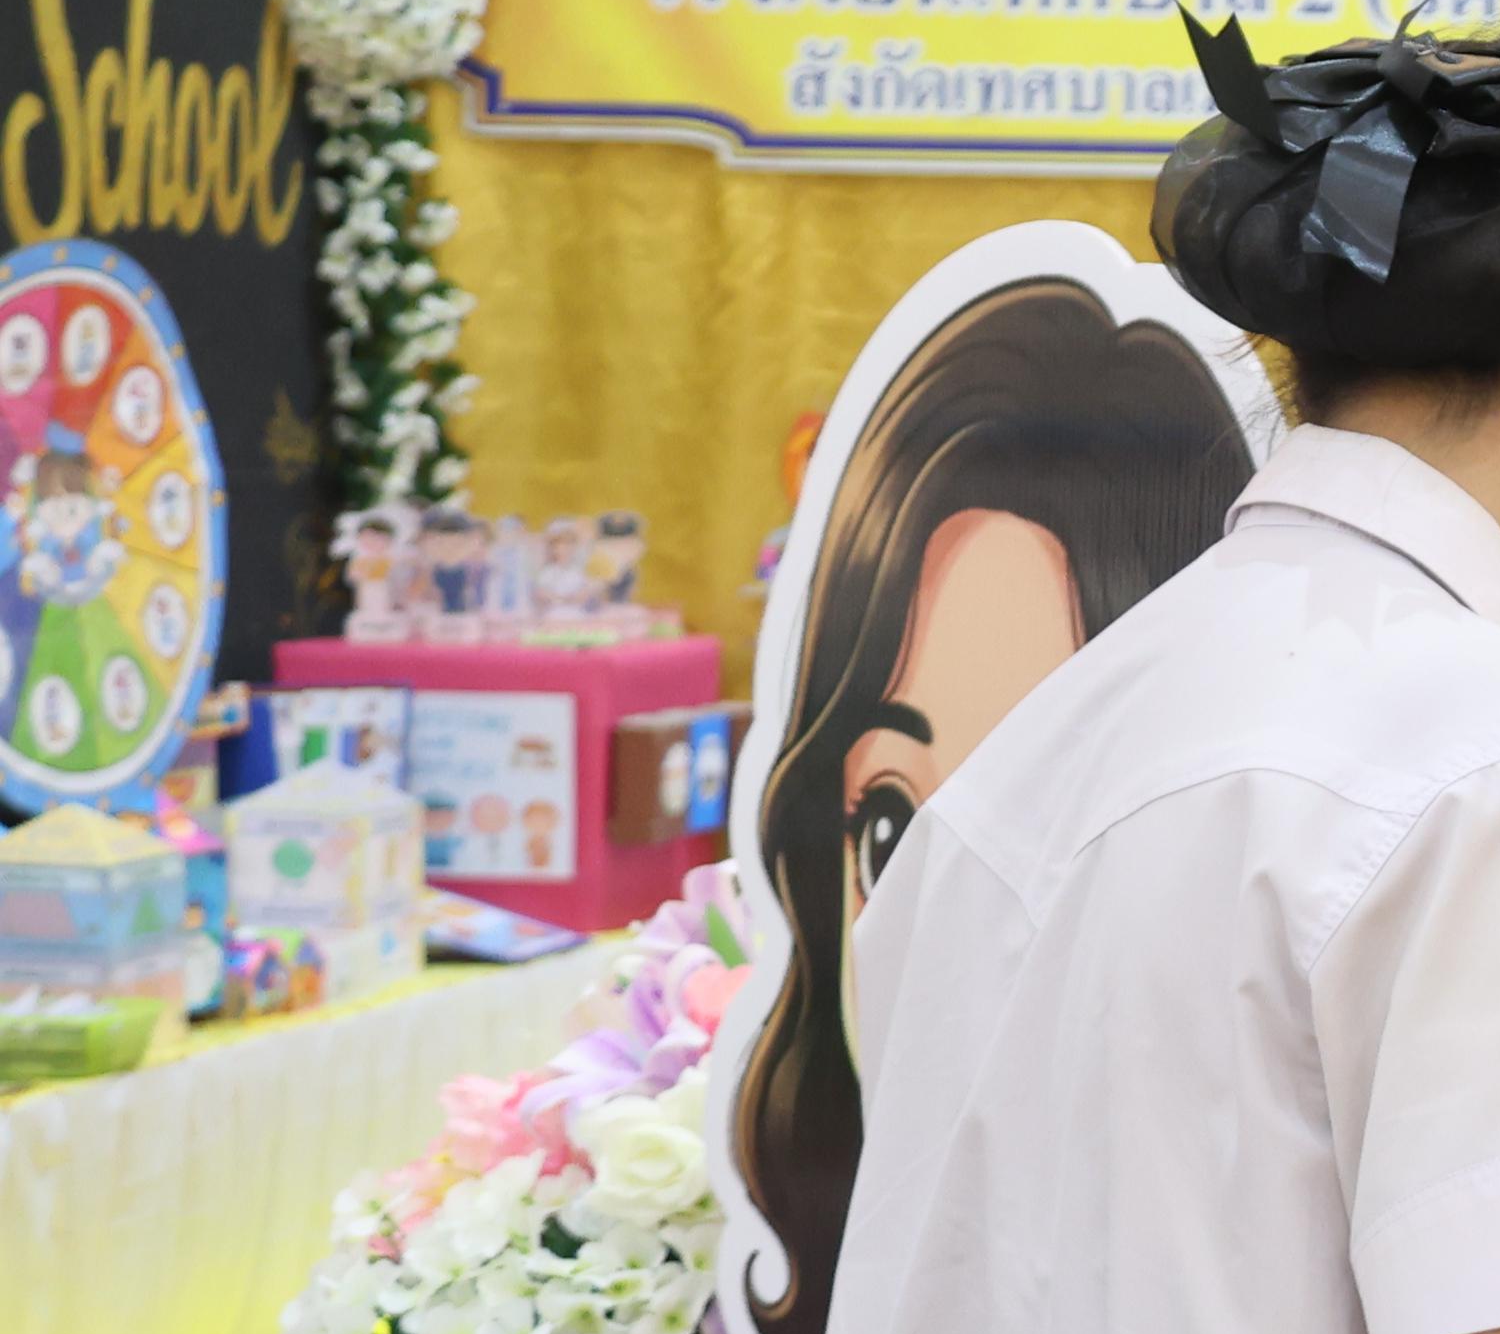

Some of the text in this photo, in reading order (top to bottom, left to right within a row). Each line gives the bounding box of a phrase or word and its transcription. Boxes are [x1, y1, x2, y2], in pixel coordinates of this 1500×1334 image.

[790, 41, 1214, 115] สังกัดเทศบาลเ
